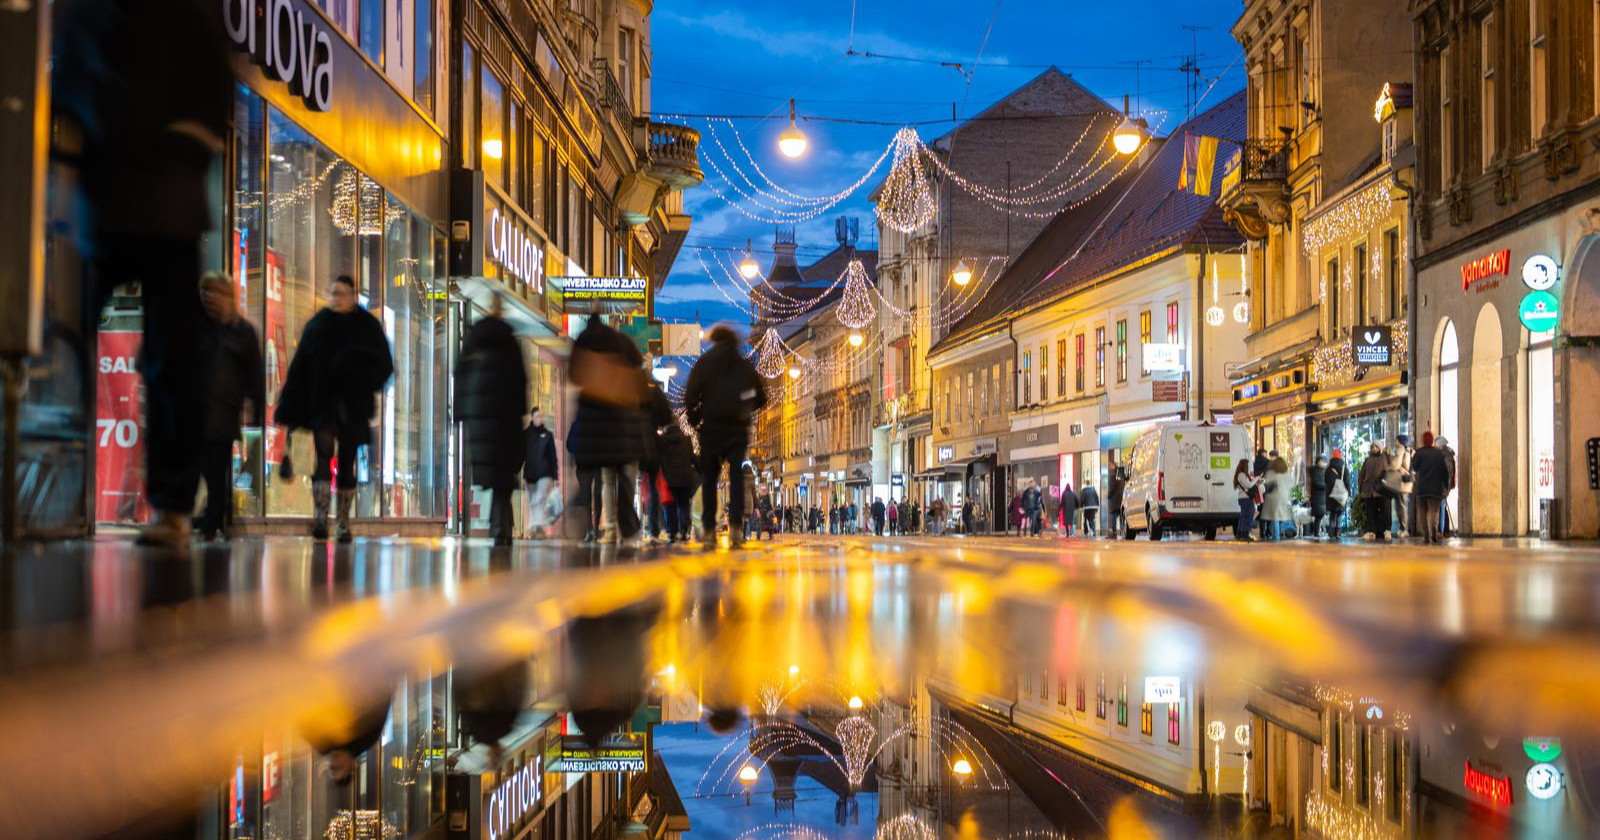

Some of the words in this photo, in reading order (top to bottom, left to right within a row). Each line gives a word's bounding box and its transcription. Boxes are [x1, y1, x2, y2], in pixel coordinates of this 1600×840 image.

[491, 208, 543, 295] CALLIOPE
[266, 262, 282, 302] LE
[563, 278, 620, 288] INVESTICIJSKO
[621, 278, 646, 288] ZLATO
[1357, 345, 1388, 353] VINCEK
[99, 356, 137, 373] SAL
